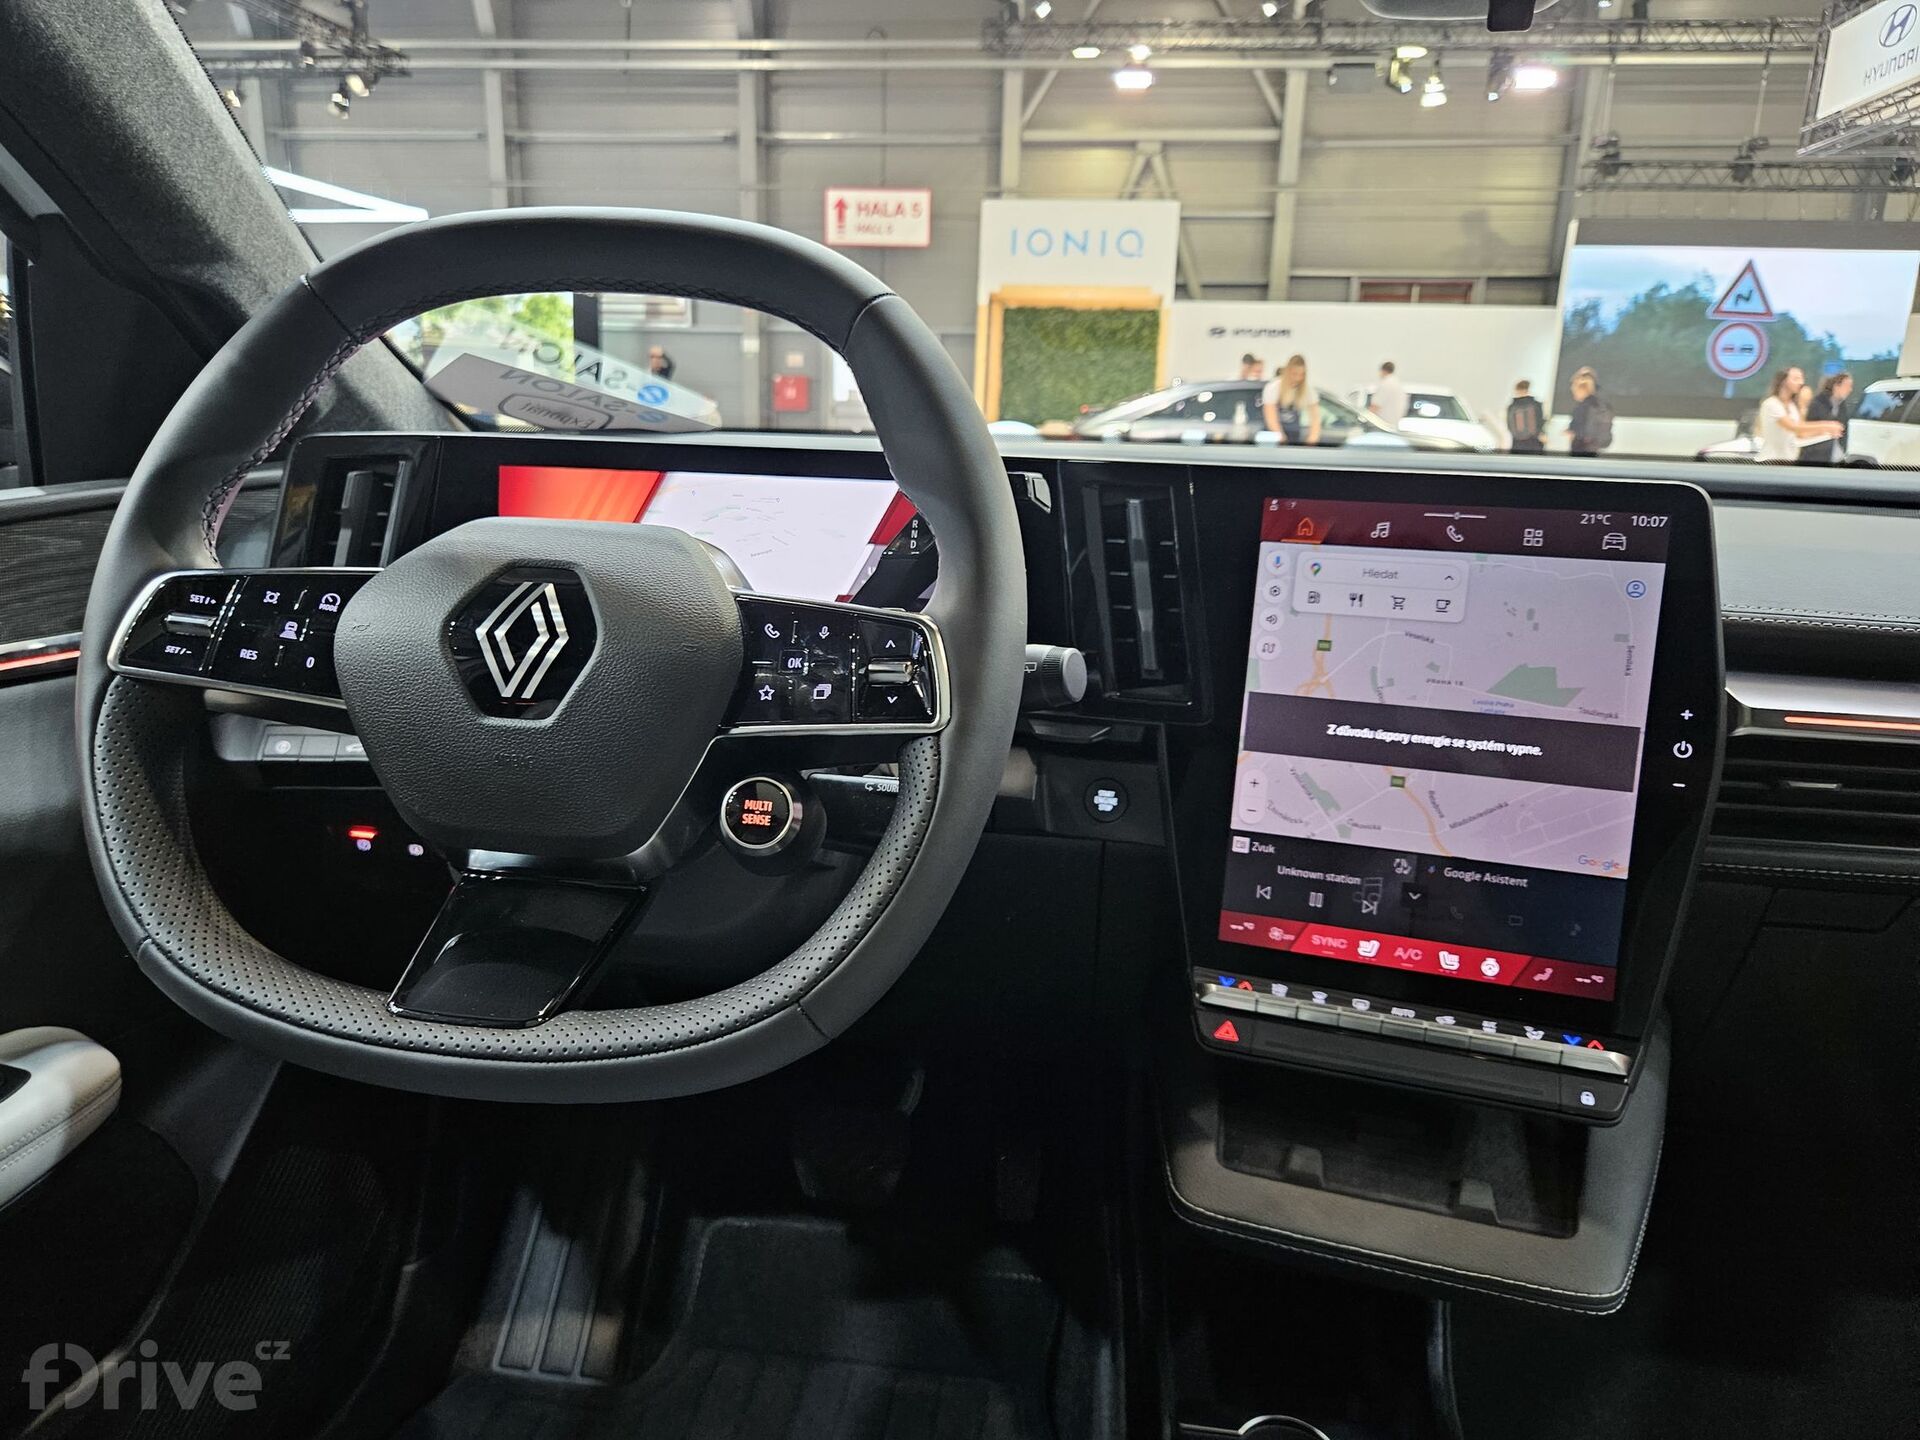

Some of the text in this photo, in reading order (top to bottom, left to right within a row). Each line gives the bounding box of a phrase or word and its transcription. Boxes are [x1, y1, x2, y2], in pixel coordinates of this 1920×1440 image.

[1863, 46, 1919, 86] HYUNDAI
[857, 201, 906, 217] HALA
[1010, 228, 1144, 258] IONIQ
[912, 519, 919, 528] R
[1580, 513, 1668, 528] 21°C 10:07
[911, 529, 918, 539] N
[910, 540, 917, 549] D
[1362, 567, 1399, 580] Hledat
[319, 603, 339, 613] MODE
[240, 648, 259, 661] RES
[787, 657, 802, 669] OK
[1326, 724, 1543, 757] Z důvodu úspory energie se systém vypne.
[744, 799, 773, 812] MULTI
[742, 813, 772, 826] SENSE
[1251, 841, 1276, 854] Zvuk
[1577, 854, 1621, 871] Google
[1277, 865, 1362, 885] Unknown station
[1443, 867, 1529, 888] Google Asistent
[1311, 934, 1348, 949] SYNC
[1393, 947, 1423, 961] A/C
